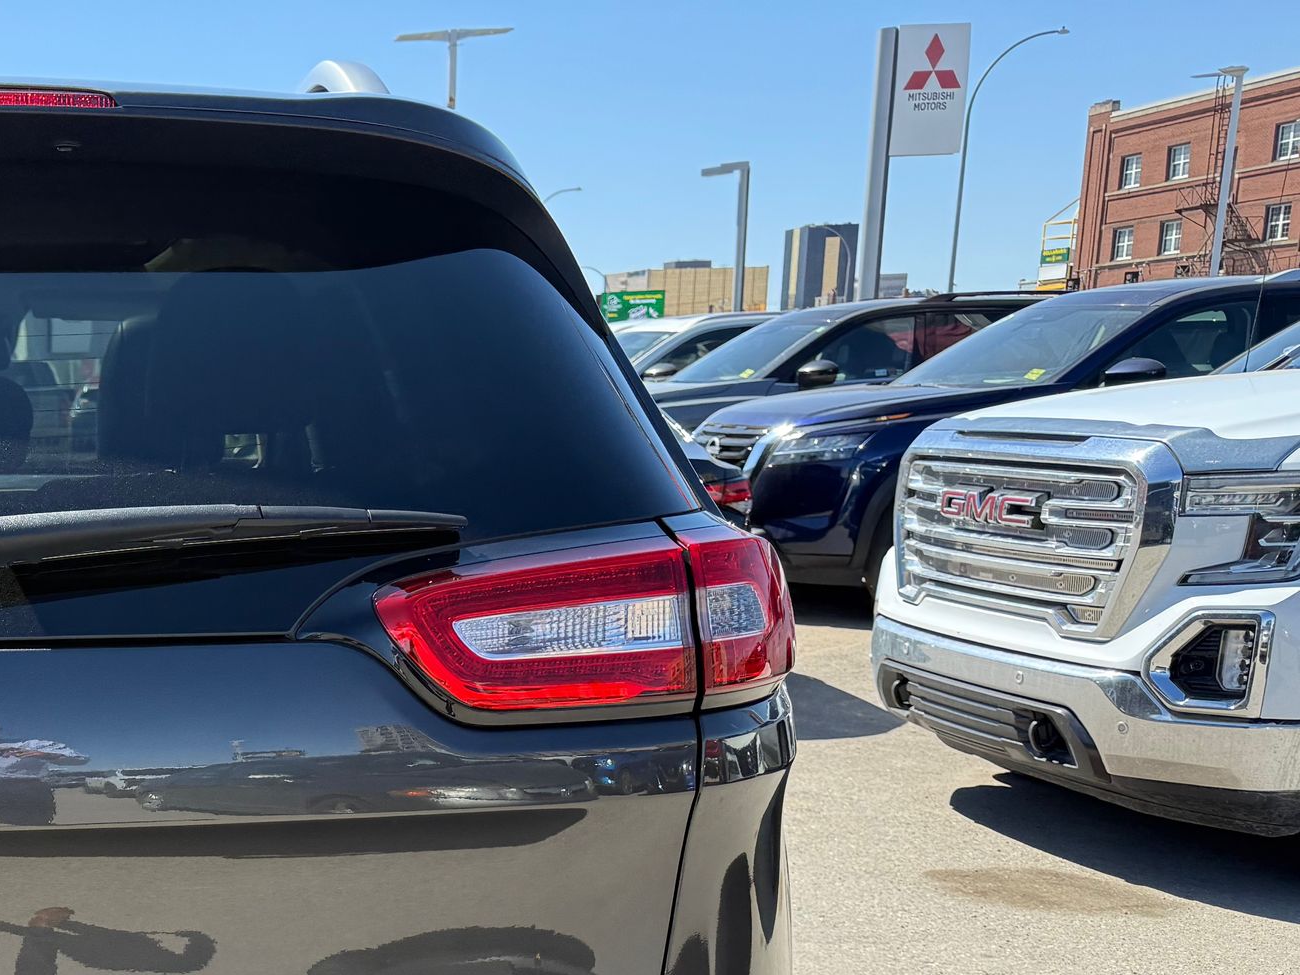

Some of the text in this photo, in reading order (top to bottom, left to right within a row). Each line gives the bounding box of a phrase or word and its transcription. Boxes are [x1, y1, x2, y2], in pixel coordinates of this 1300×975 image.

[908, 92, 954, 101] MITSUBISHI
[913, 101, 947, 111] MOTORS
[940, 488, 1037, 529] GMC
